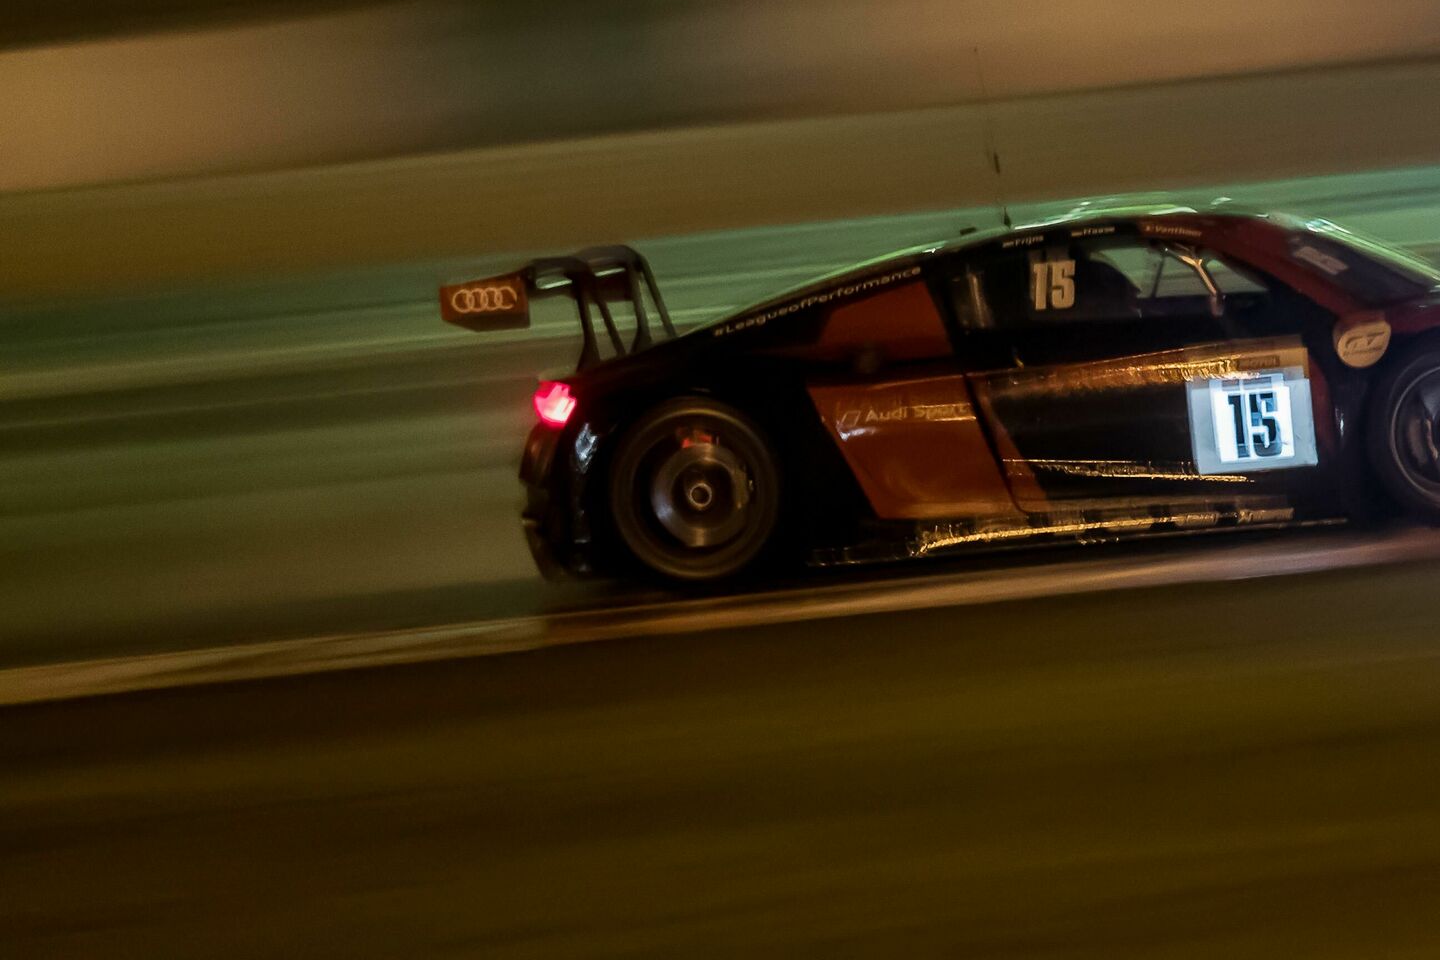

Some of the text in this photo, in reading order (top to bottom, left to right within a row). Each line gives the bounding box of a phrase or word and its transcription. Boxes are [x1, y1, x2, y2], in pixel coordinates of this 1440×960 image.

[1032, 257, 1077, 310] 15
[865, 404, 908, 420] Audi
[1227, 390, 1281, 458] 15
